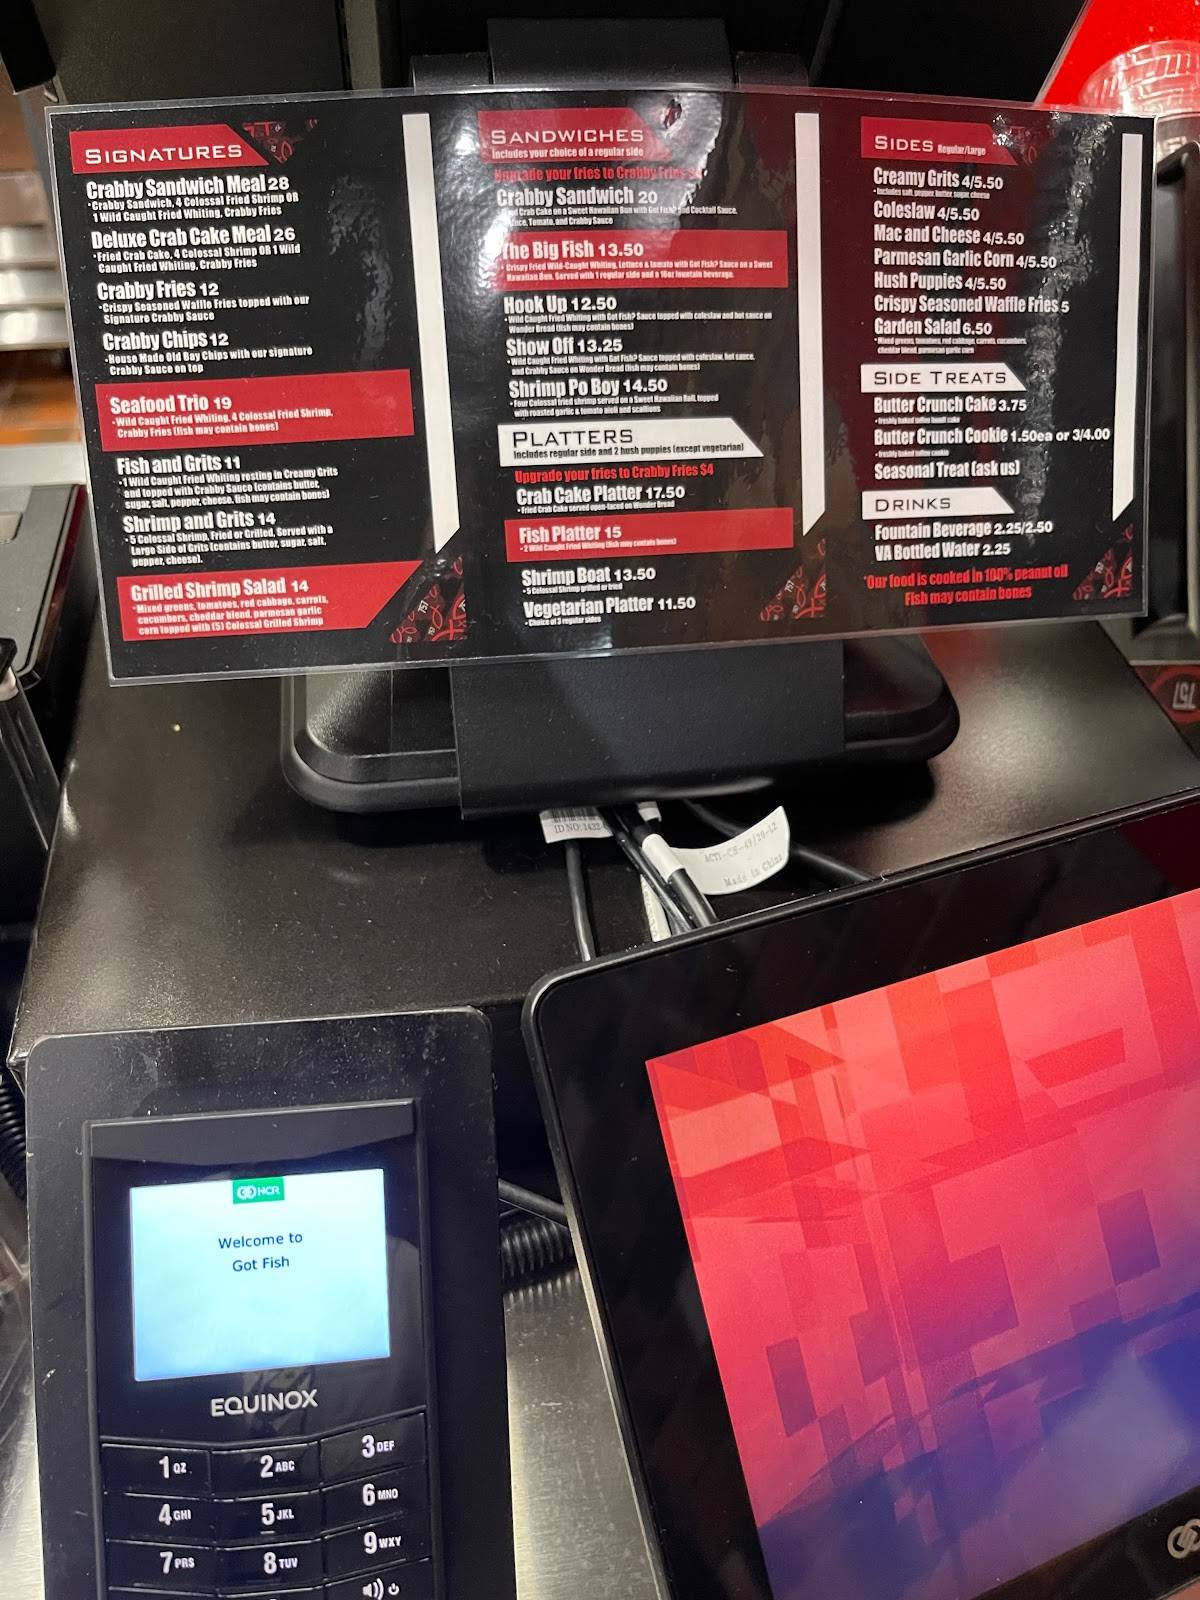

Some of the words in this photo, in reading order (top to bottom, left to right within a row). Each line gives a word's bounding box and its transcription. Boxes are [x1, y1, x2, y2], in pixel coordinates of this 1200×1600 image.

[937, 144, 986, 155] Regular/Large
[86, 180, 143, 198] Crabby
[145, 176, 224, 196] Sandwich
[226, 174, 266, 192] Meal
[267, 176, 289, 190] 28
[873, 167, 925, 186] Creamy
[927, 169, 959, 186] Grits
[961, 175, 1003, 189] 4/5.50
[91, 200, 124, 210] Crabby
[175, 196, 182, 207] 4
[183, 195, 224, 206] Colossal
[225, 194, 249, 204] Fried
[251, 193, 284, 203] Shrimp
[285, 191, 298, 202] OR
[497, 186, 553, 206] Crabby
[556, 186, 635, 204] Sandwich
[638, 189, 658, 204] 20
[874, 201, 935, 218] Coleslaw
[936, 207, 979, 220] 4/5.50
[91, 231, 146, 248] Deluxe
[148, 228, 187, 246] Crab
[189, 227, 230, 244] Cake
[231, 224, 271, 242] Meal
[273, 227, 295, 241] 26
[874, 224, 902, 241] Mac
[904, 225, 929, 242] and
[932, 226, 980, 243] Cheese
[982, 232, 1024, 244] 4/5.50
[532, 241, 558, 260] Big
[561, 240, 594, 257] Fish
[598, 242, 644, 256] 13.50
[874, 248, 940, 265] Parmesan
[942, 249, 981, 266] Garlic
[983, 250, 1014, 266] Corn
[1015, 254, 1057, 268] 4/5.50
[97, 281, 154, 299] Crabby
[155, 280, 196, 297] Fries
[199, 282, 219, 295] 12
[874, 271, 907, 288] Hush
[910, 272, 962, 289] Puppies
[964, 277, 1006, 290] 4/5.50
[503, 296, 544, 313] Hook
[546, 294, 567, 313] Up
[570, 296, 616, 310] 12.50
[874, 294, 917, 312] Crispy
[918, 295, 982, 311] Seasoned
[984, 296, 1026, 312] Waffle
[1028, 295, 1059, 312] Fries
[1060, 300, 1069, 312] 5
[874, 318, 922, 334] Garden
[924, 318, 960, 334] Salad
[962, 322, 992, 334] 6.50
[103, 332, 159, 350] Crabby
[161, 330, 207, 348] Chips
[209, 332, 229, 346] 12
[506, 338, 549, 355] Show
[552, 336, 574, 354] Off
[577, 338, 622, 352] 13.25
[509, 380, 565, 397] Shrimp
[568, 378, 588, 395] Po
[590, 377, 619, 396] Boy
[623, 378, 668, 392] 14.50
[110, 395, 175, 413] Seafood
[176, 394, 208, 411] Trio
[213, 396, 231, 409] 19
[874, 397, 914, 412] Butter
[916, 396, 962, 412] Crunch
[965, 396, 996, 411] Cake
[998, 399, 1027, 411] 3.75
[874, 429, 914, 444] Butter
[916, 428, 962, 443] Crunch
[965, 427, 1008, 442] Cookie
[1010, 430, 1052, 441] 1.50ea
[1055, 431, 1069, 441] or
[1072, 428, 1110, 440] 3/4.00
[514, 450, 548, 458] Includes
[549, 448, 578, 458] regular
[579, 447, 596, 456] side
[597, 447, 612, 455] and
[613, 446, 618, 455] 2
[620, 446, 639, 454] hush
[640, 445, 671, 454] puppies
[672, 444, 700, 452] (except
[701, 443, 744, 452] vegetarian)
[117, 457, 150, 474] Fish
[151, 455, 182, 472] and
[184, 454, 222, 471] Grits
[224, 456, 240, 469] 11
[874, 462, 934, 478] Seasonal
[936, 461, 969, 477] Treat
[971, 460, 998, 476] (ask
[1000, 459, 1020, 475] us)
[516, 488, 552, 504] Crab
[554, 486, 591, 503] Cake
[593, 485, 642, 501] Platter
[645, 485, 685, 498] 17.50
[123, 515, 181, 532] Shrimp
[183, 512, 214, 529] and
[216, 510, 254, 527] Grits
[257, 512, 276, 524] 14
[875, 523, 930, 539] Fountain
[932, 522, 991, 537] Beverage
[993, 521, 1053, 534] 2.25/2.50
[519, 526, 549, 543] Fish
[551, 525, 600, 541] Platter
[604, 526, 621, 538] 15
[875, 545, 892, 560] VA
[894, 543, 940, 559] Bottled
[941, 541, 980, 557] Water
[982, 542, 1010, 555] 2.25
[521, 569, 575, 585] Shrimp
[576, 566, 611, 583] Boat
[614, 567, 656, 580] 13.50
[889, 573, 915, 586] food
[916, 573, 927, 585] is
[928, 571, 970, 584] cooked
[971, 570, 983, 582] in
[985, 568, 1013, 580] 100%
[1014, 566, 1052, 580] peanut
[1052, 564, 1068, 576] oil
[131, 583, 183, 600] Grilled
[184, 581, 240, 598] Shrimp
[242, 577, 286, 594] Salad
[290, 580, 308, 592] 14
[905, 592, 928, 604] Fish
[929, 592, 954, 603] may
[954, 589, 996, 600] contain
[997, 587, 1031, 598] bones
[523, 599, 604, 616] Vegetarian
[605, 596, 654, 612] Platter
[657, 596, 696, 609] 11.50
[258, 1186, 280, 1196] NCR
[218, 1235, 284, 1249] Welcome
[289, 1232, 303, 1244] to
[232, 1260, 258, 1272] Got
[262, 1256, 290, 1269] Fish
[210, 1389, 318, 1418] EQUINOX
